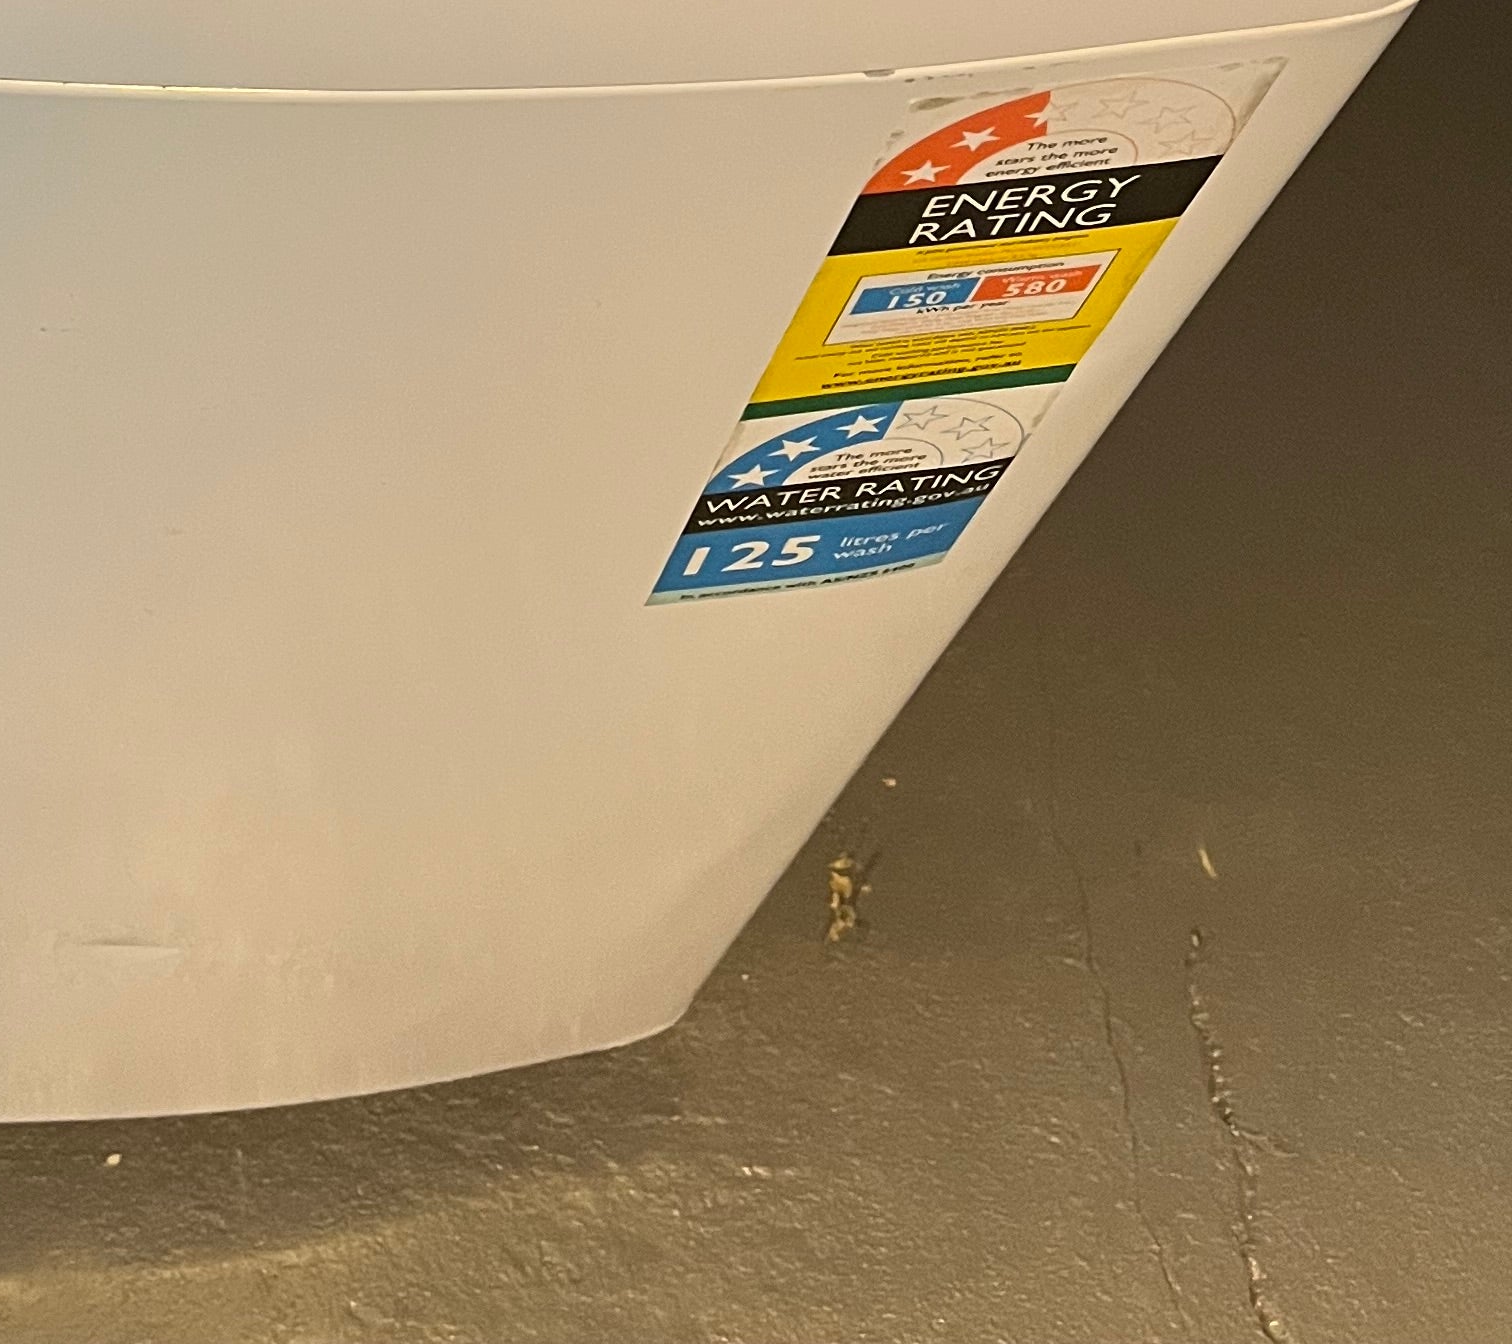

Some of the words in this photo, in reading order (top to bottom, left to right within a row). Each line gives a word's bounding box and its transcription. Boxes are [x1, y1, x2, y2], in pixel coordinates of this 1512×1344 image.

[1028, 142, 1058, 152] The
[1062, 137, 1108, 148] more
[995, 156, 1035, 167] stars
[1041, 152, 1068, 163] the
[1073, 146, 1119, 159] more
[985, 165, 1038, 178] energy
[1046, 158, 1112, 172] efficient
[921, 174, 1141, 219] ENERGY
[908, 203, 1117, 244] RATING
[927, 269, 972, 281] Energy
[1001, 278, 1068, 298] 580
[887, 291, 947, 310] 150
[809, 463, 849, 474] stars
[852, 458, 880, 470] the
[882, 453, 927, 465] more
[835, 452, 866, 463] The
[869, 446, 913, 459] more
[807, 468, 853, 480] water
[857, 462, 921, 475] efficient
[706, 485, 842, 514] WATER
[854, 465, 1004, 497] RATING
[697, 482, 990, 528] www.waterrating.gov.au
[839, 531, 905, 549] litres
[906, 521, 949, 541] per
[682, 534, 821, 577] 125
[833, 543, 893, 561] wash
